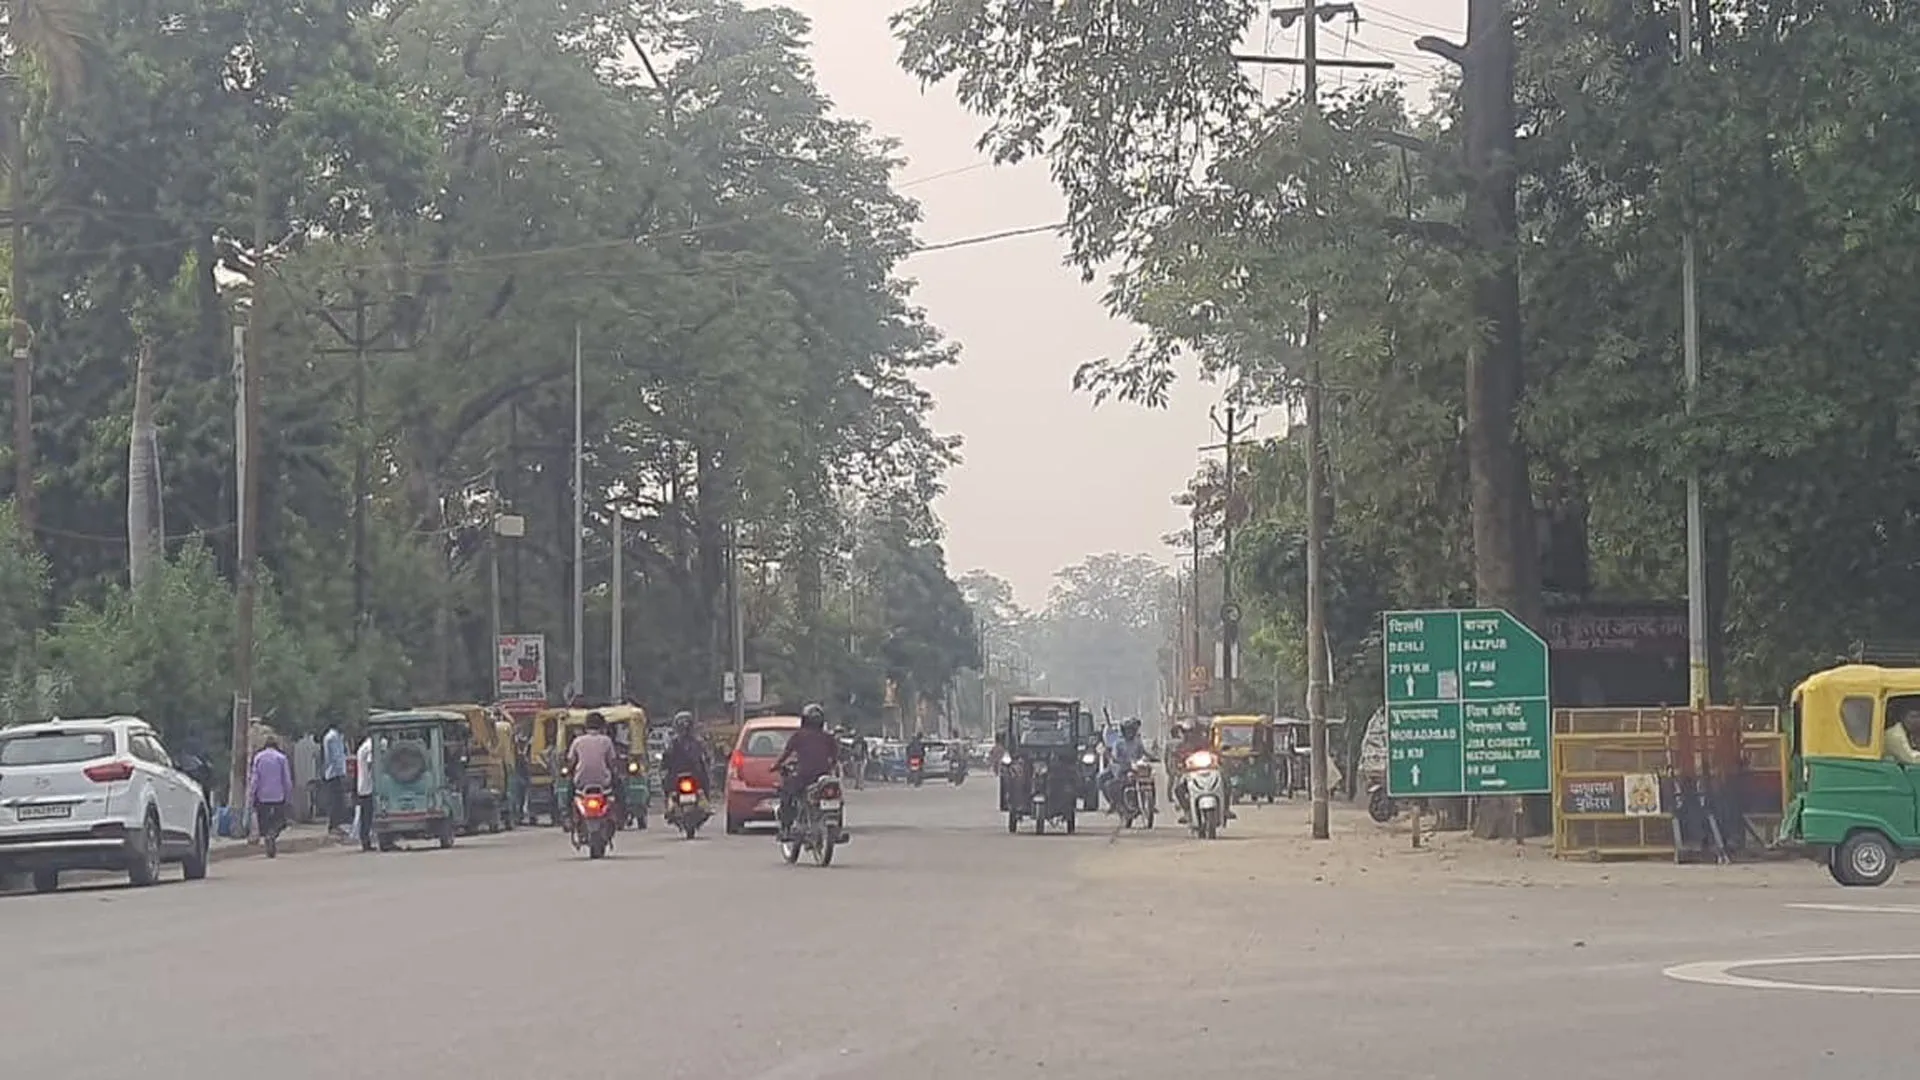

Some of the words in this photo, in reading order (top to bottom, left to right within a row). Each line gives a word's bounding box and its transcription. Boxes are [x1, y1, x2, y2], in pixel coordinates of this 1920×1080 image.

[1463, 638, 1508, 651] BAZPUR
[1412, 663, 1430, 673] KM
[1479, 660, 1496, 672] KM
[1390, 729, 1457, 740] MORADABAD
[1466, 739, 1486, 749] JIM
[1407, 747, 1424, 759] KM
[1465, 750, 1514, 761] NATIONAL
[1515, 749, 1541, 760] PARK
[1481, 764, 1497, 775] KM
